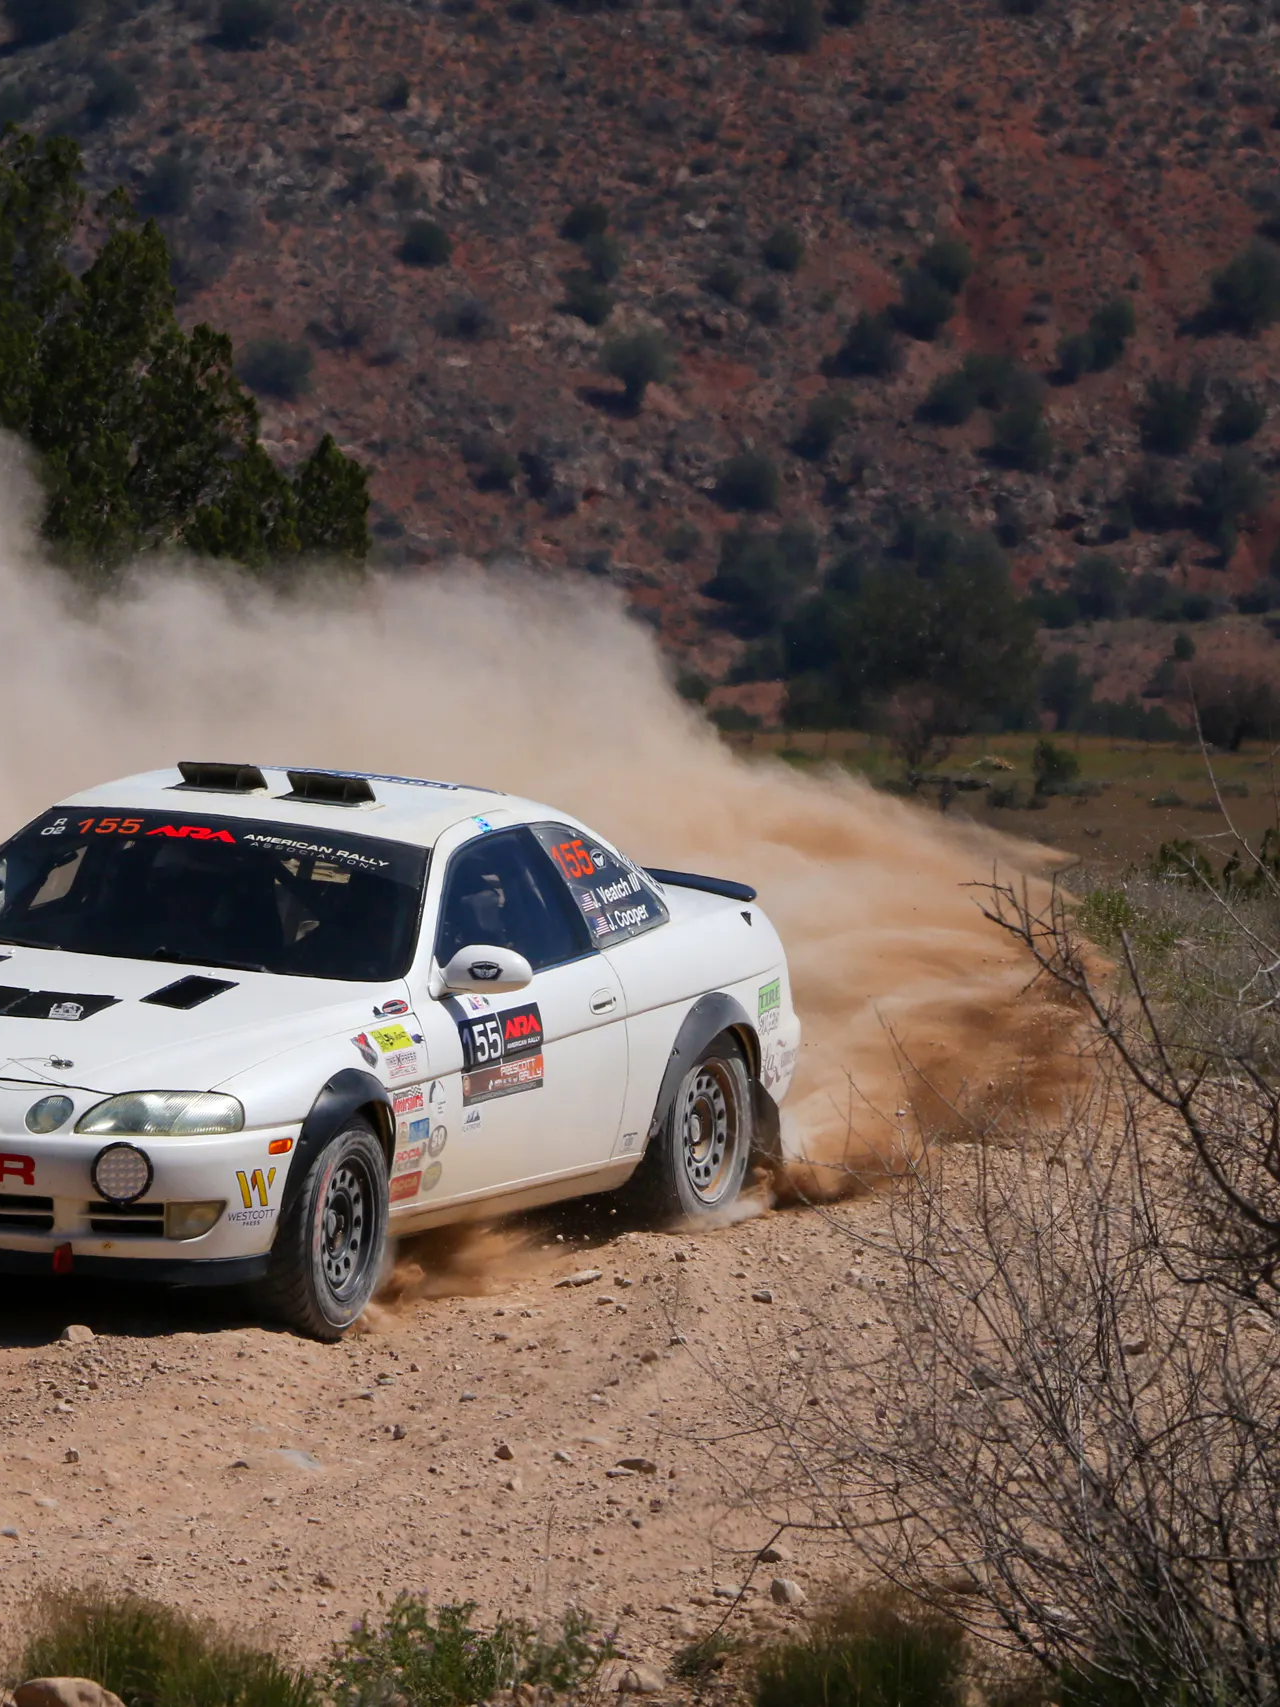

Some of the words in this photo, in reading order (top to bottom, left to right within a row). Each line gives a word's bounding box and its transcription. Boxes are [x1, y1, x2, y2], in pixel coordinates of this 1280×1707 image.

[77, 817, 145, 835] 155
[145, 825, 236, 844] ARA
[243, 833, 333, 855] AMERICAN
[336, 849, 390, 868] RALLY
[250, 841, 371, 871] ASSOCIATION
[551, 839, 595, 880] 155
[596, 877, 632, 905] Veatch
[606, 916, 618, 932] J.
[614, 903, 649, 927] Cooper
[759, 984, 780, 1009] TIRE
[505, 1013, 542, 1040] ARA
[462, 1020, 502, 1066] 155
[506, 1039, 528, 1050] AMERICAN
[527, 1035, 541, 1046] RALLY
[500, 1058, 536, 1076] PRESCOTT
[518, 1066, 543, 1081] RALLY
[227, 1208, 276, 1222] WESTCOTT
[242, 1219, 261, 1227] PRESS
